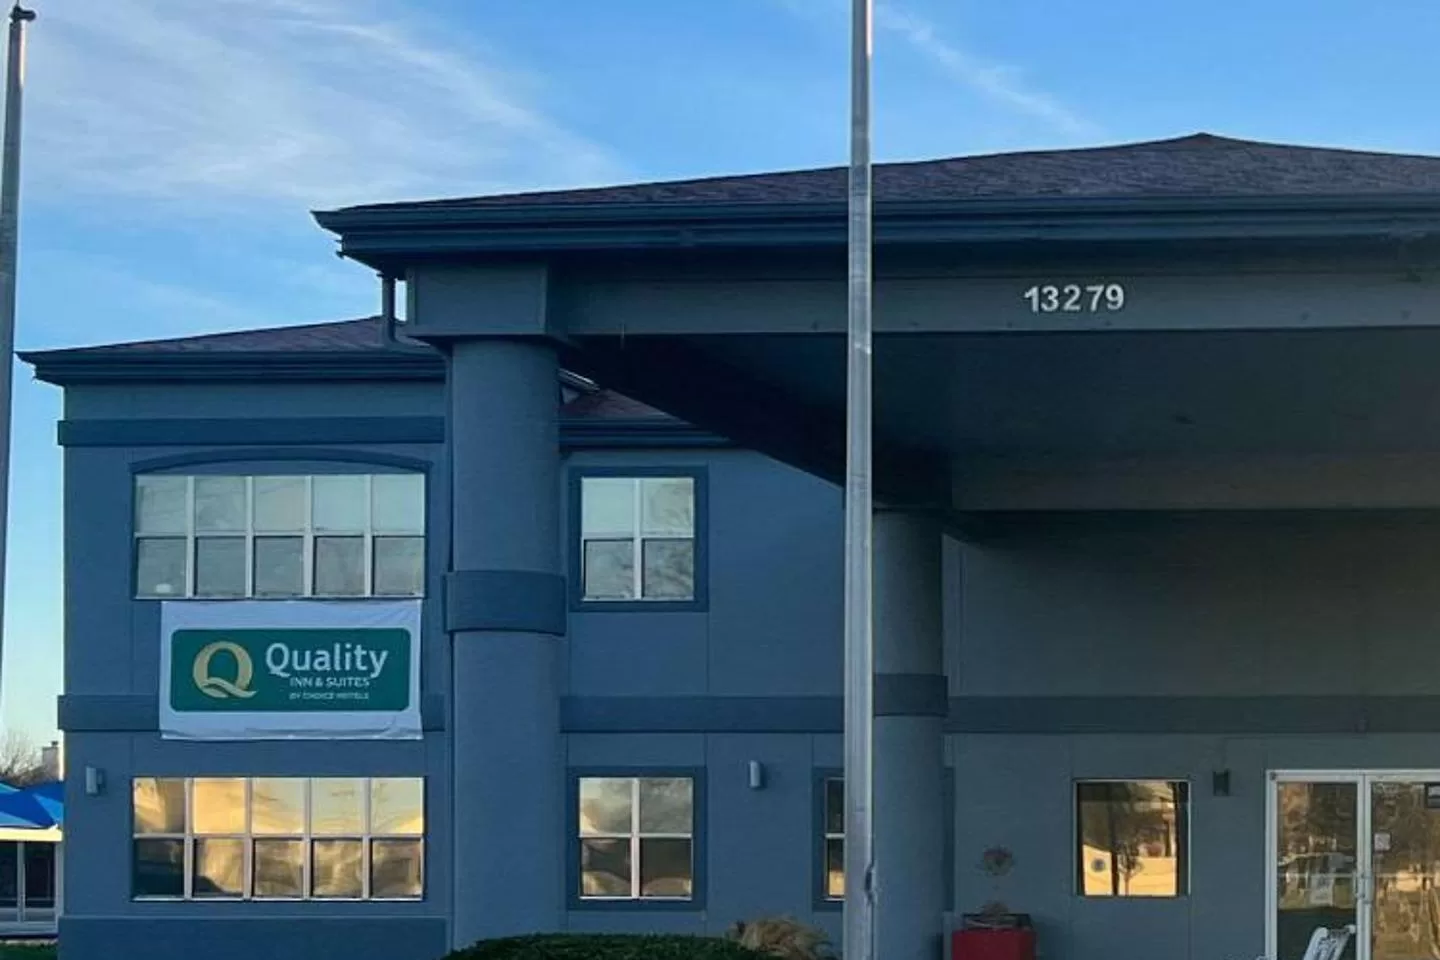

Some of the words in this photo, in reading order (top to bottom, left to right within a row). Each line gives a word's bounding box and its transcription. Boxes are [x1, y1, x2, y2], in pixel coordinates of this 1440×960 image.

[1024, 284, 1124, 312] 13279
[192, 641, 257, 698] Q
[265, 642, 389, 678] Quality
[290, 677, 313, 688] INN
[326, 676, 370, 689] SUITES
